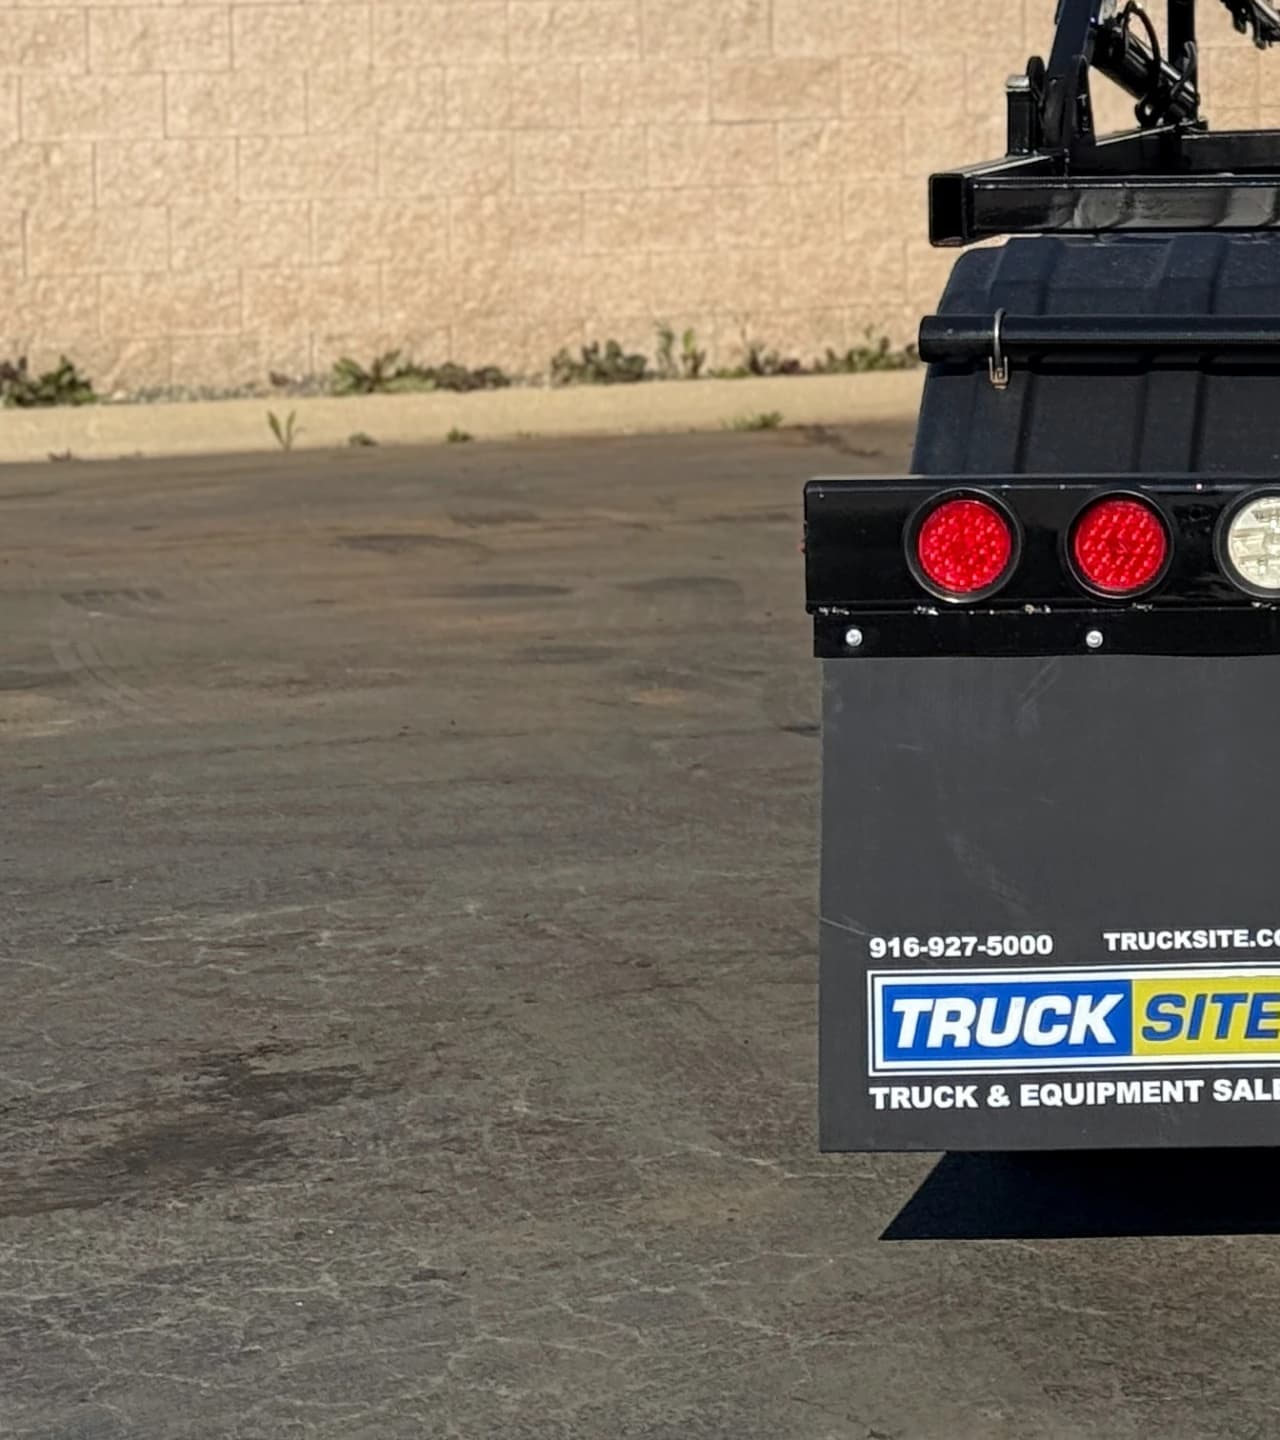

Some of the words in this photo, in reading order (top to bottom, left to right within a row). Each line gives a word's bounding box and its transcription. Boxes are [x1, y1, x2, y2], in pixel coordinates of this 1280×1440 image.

[869, 934, 1053, 959] 916-927-5000
[892, 993, 1125, 1049] TRUCK
[869, 1085, 979, 1111] TRUCK
[987, 1084, 1011, 1108] &
[1020, 1079, 1204, 1107] EQUIPMENT
